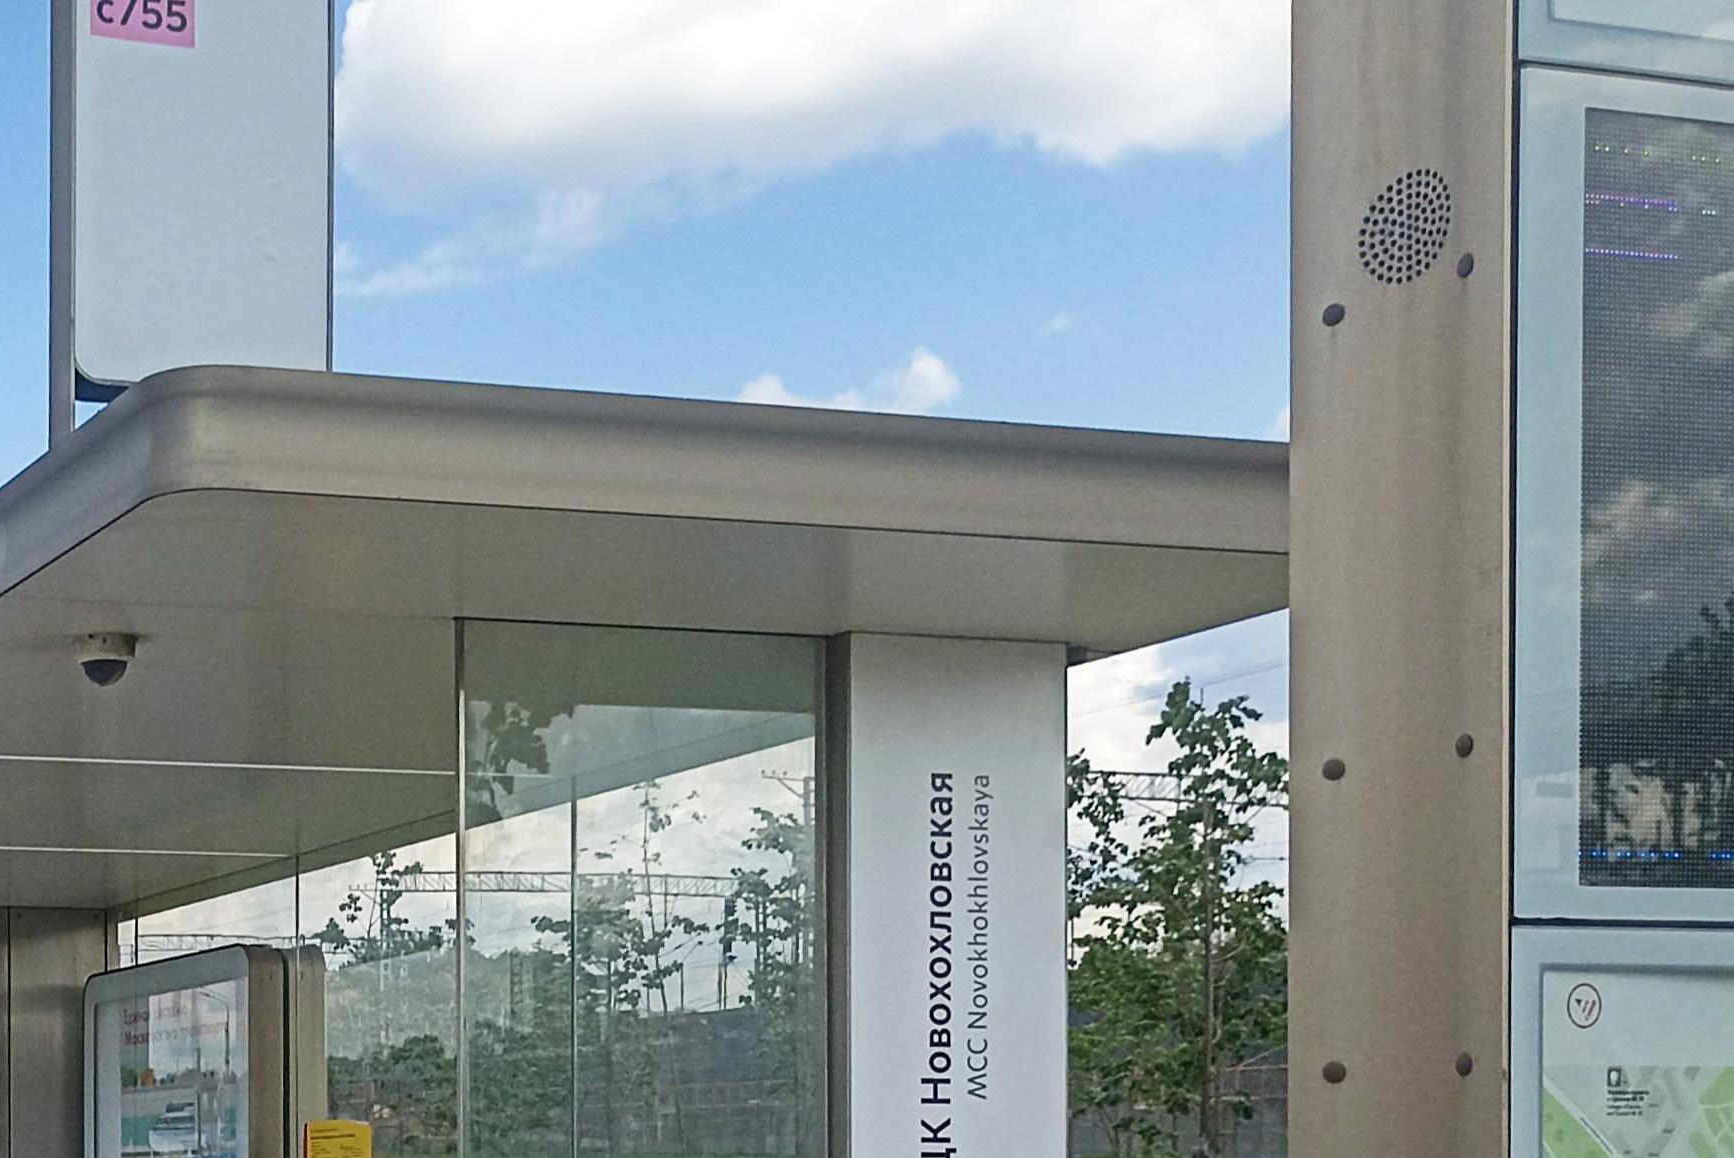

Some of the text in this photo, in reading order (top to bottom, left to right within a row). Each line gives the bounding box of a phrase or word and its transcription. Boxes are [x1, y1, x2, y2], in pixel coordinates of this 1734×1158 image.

[920, 772, 954, 1105] Новохохловская
[966, 774, 994, 1100] MCC Novokhokhlovskaya
